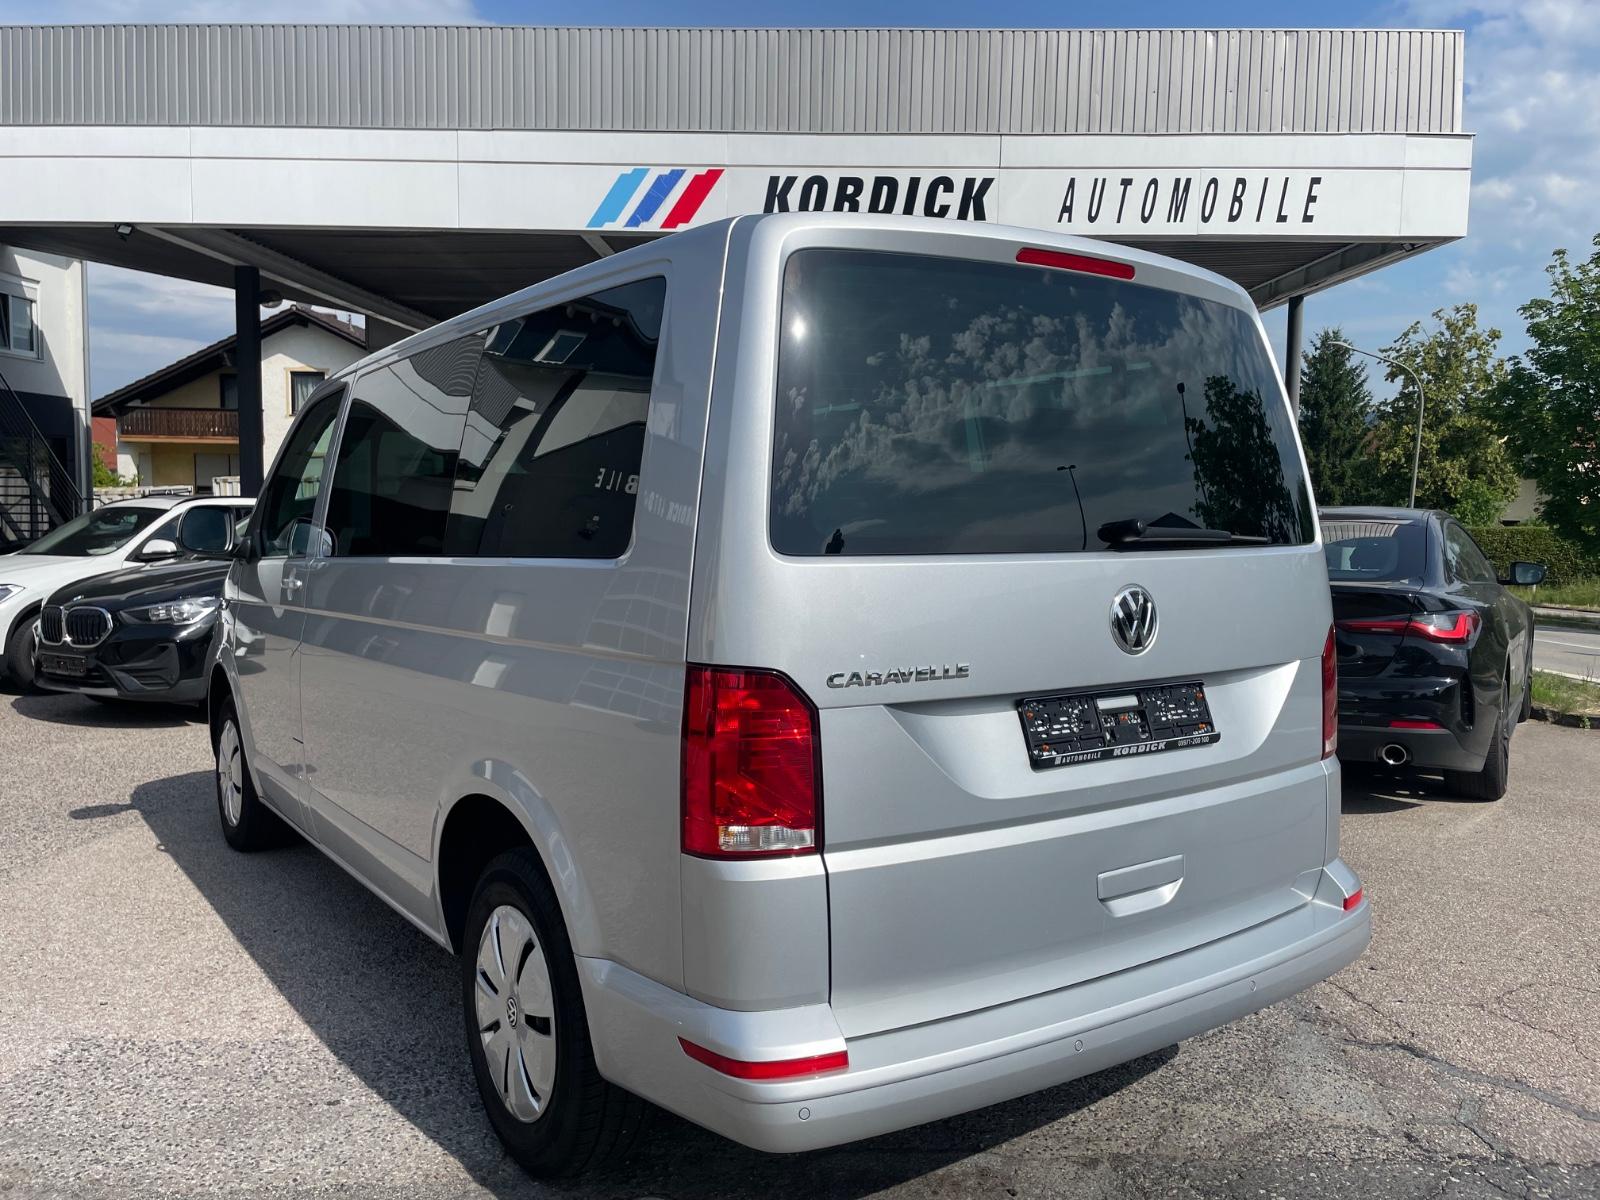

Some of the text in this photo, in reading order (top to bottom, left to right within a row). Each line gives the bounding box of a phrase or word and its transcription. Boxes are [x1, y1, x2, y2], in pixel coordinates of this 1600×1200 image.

[763, 175, 1321, 223] KORDICK AUTOMOBILE
[827, 663, 970, 689] CARAVELLE
[1063, 752, 1101, 762] AUTOMOBILE
[1113, 743, 1166, 755] KORDICK
